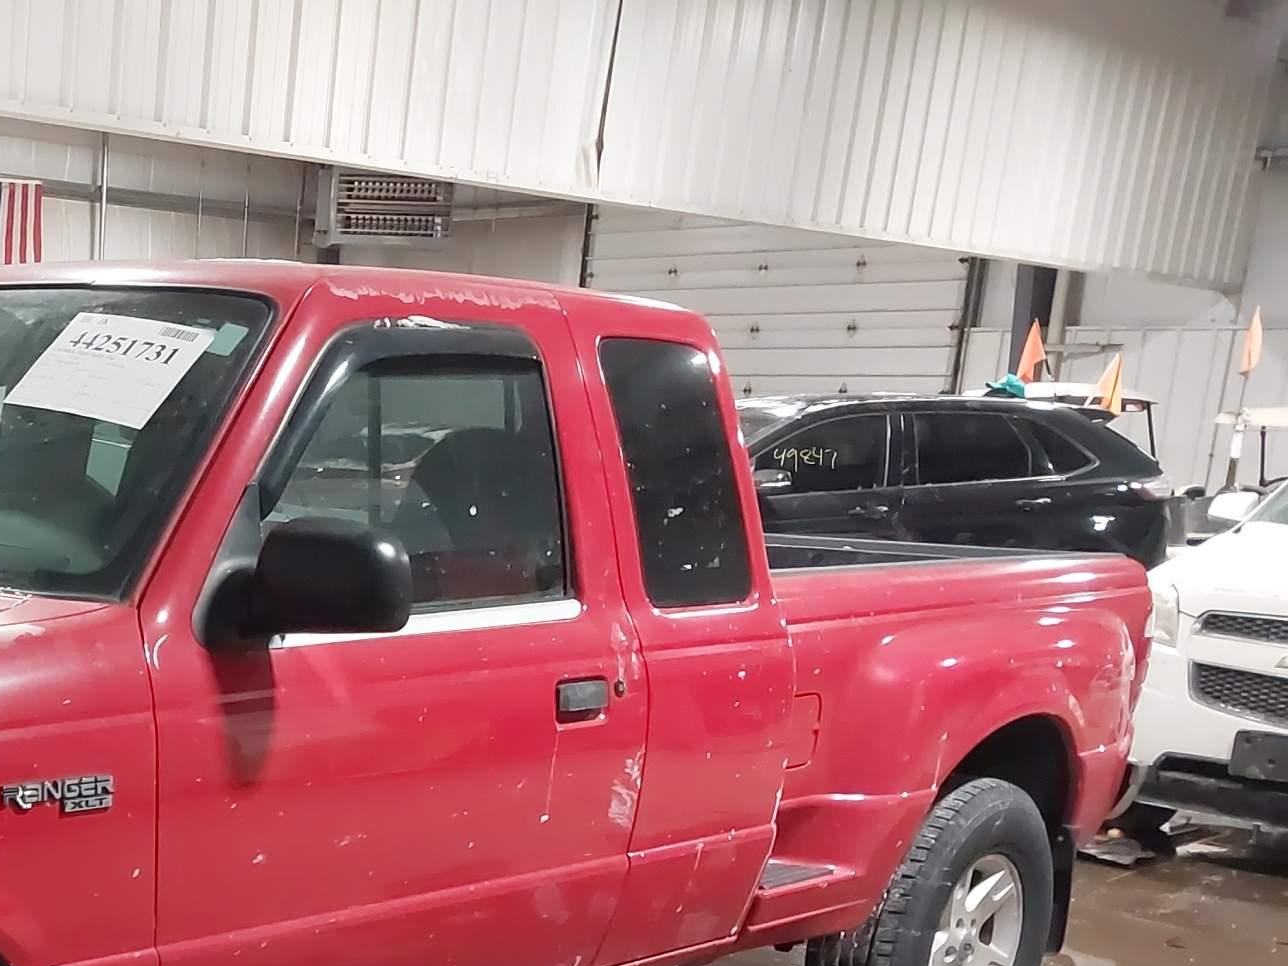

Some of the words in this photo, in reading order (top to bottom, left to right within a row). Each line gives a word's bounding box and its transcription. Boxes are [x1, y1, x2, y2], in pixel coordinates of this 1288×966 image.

[70, 331, 180, 366] 44251731
[773, 446, 837, 472] 49847
[1, 776, 114, 809] RANGER
[68, 797, 110, 810] XLT
